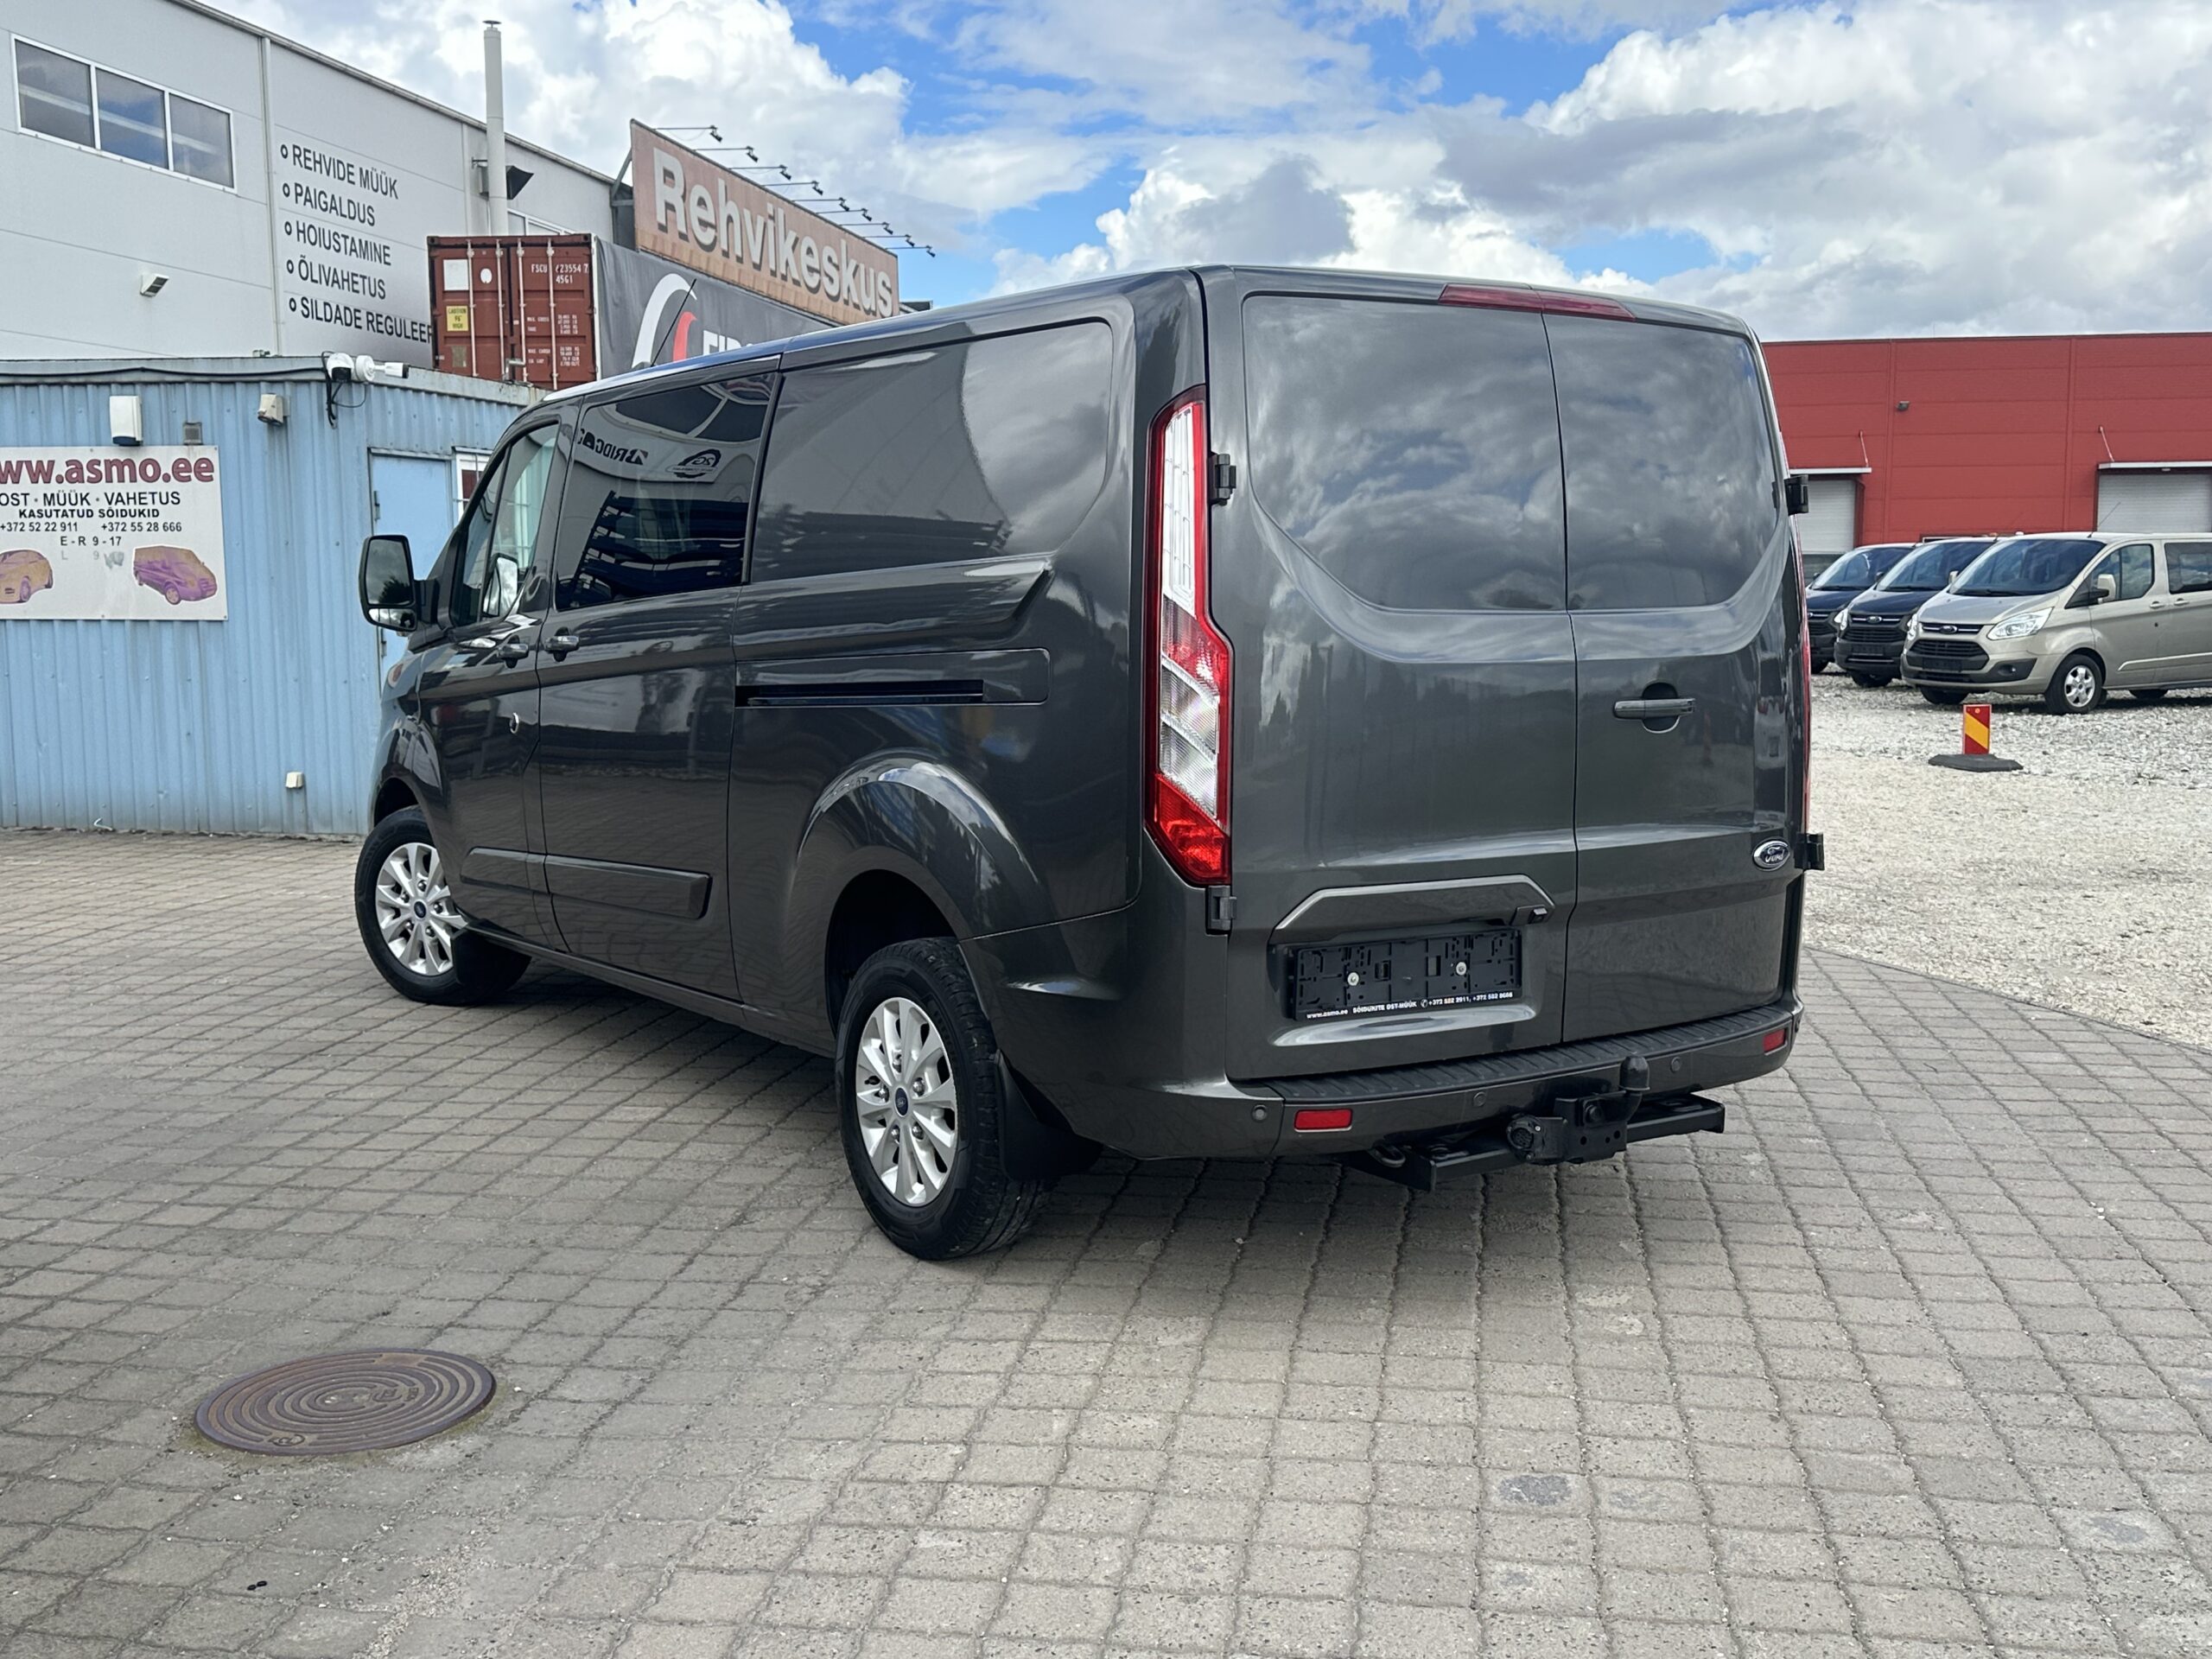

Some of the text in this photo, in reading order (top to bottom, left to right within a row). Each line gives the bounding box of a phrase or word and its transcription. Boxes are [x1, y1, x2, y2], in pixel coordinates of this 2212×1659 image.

[292, 143, 399, 200] REHVIDE MÜÜK
[294, 182, 376, 226] PAIGALDUS
[296, 220, 391, 266] HOIUSTAMINE
[652, 146, 893, 319] Rehvikeskus
[298, 255, 386, 300] ÕLIVAHETUS
[301, 296, 362, 330] SILDADE
[0, 489, 181, 506] OST MÜÜK VAHETUS
[19, 507, 160, 518] KASUTATUD SÕIDUKID
[1, 522, 78, 532] +372 52 22 911
[101, 522, 182, 532] +372 55 28 666
